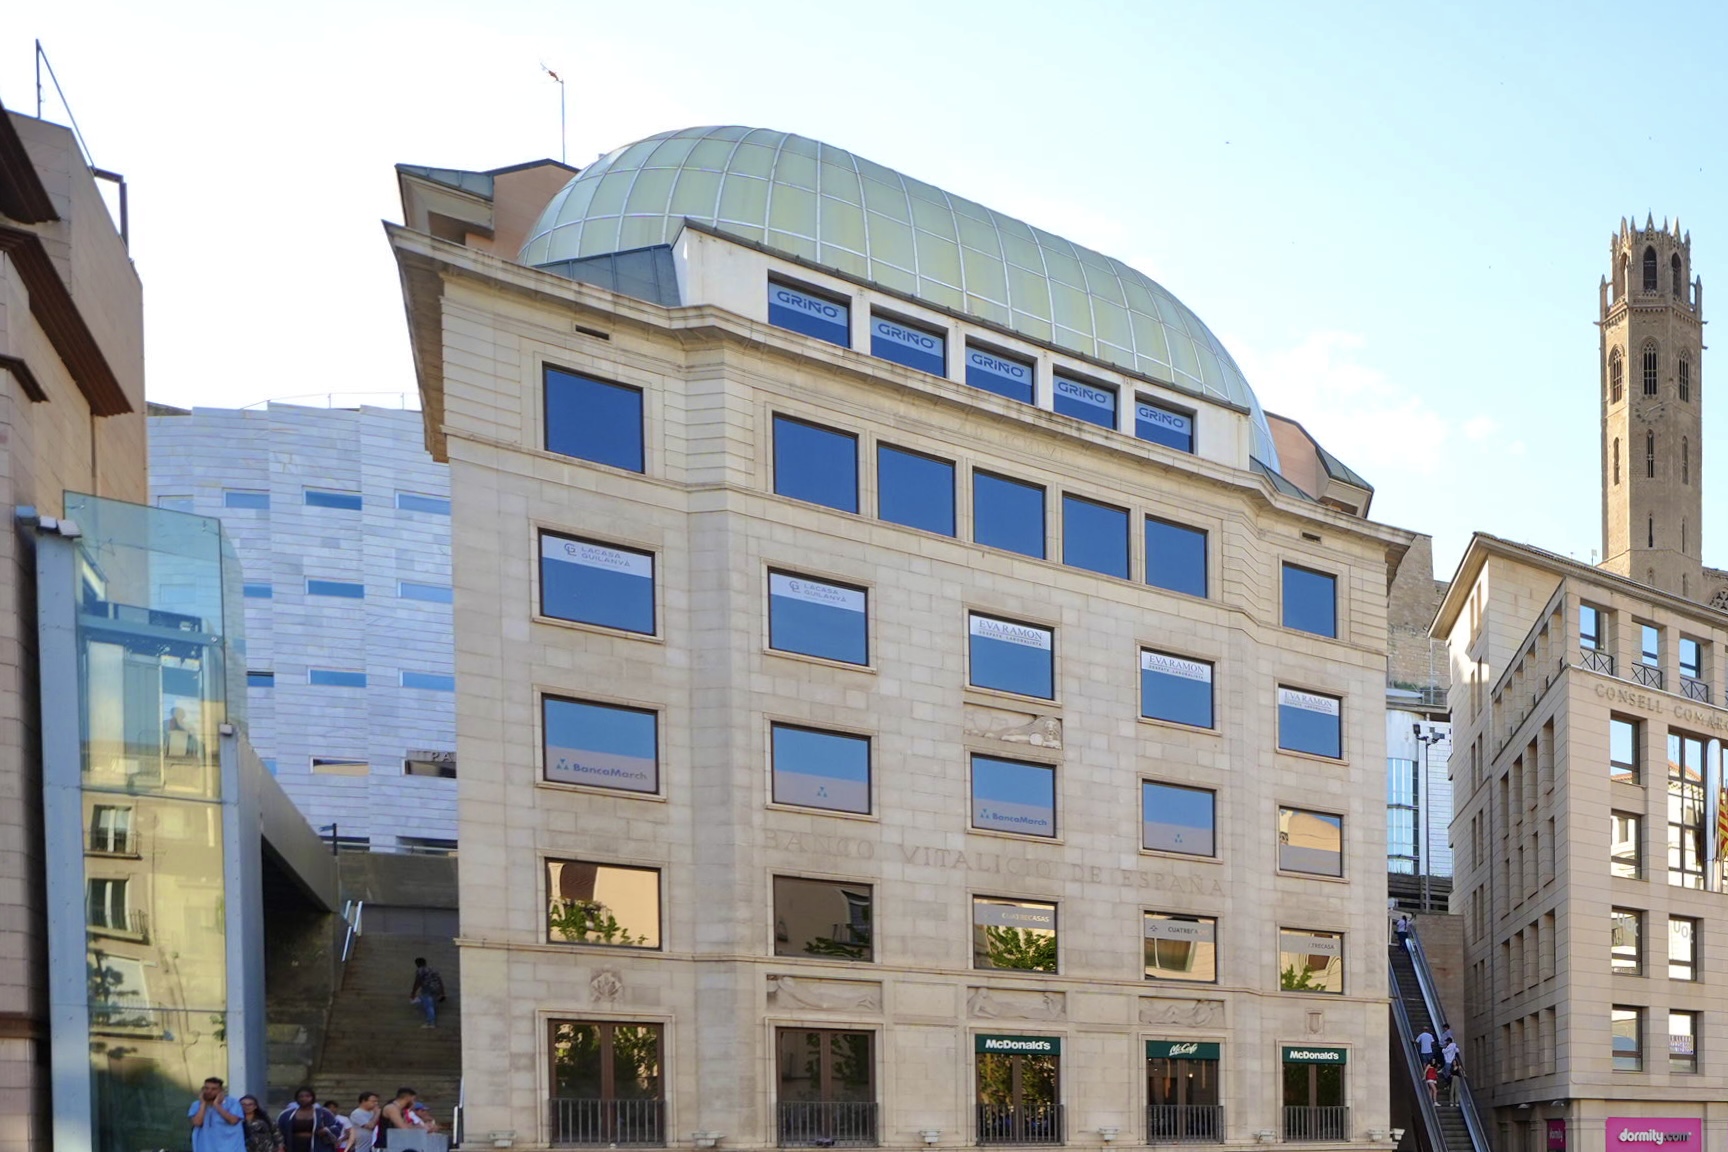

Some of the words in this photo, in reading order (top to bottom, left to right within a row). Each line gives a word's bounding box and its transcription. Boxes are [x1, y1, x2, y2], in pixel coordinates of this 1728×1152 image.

[979, 620, 1000, 631] EVA
[1003, 626, 1042, 640] RAMON
[1149, 655, 1167, 666] EVA
[1169, 660, 1204, 673] RAMON
[1595, 683, 1663, 713] CONSELL
[573, 763, 647, 780] BancaMarch
[992, 812, 1047, 826] BancaMarch
[761, 828, 875, 860] BANCO
[899, 843, 1052, 879] VITALICIO
[1072, 863, 1102, 884] DE
[1121, 869, 1226, 897] ESPAÑA
[985, 1038, 1051, 1051] McDonald's
[1290, 1049, 1339, 1061] McDonald's
